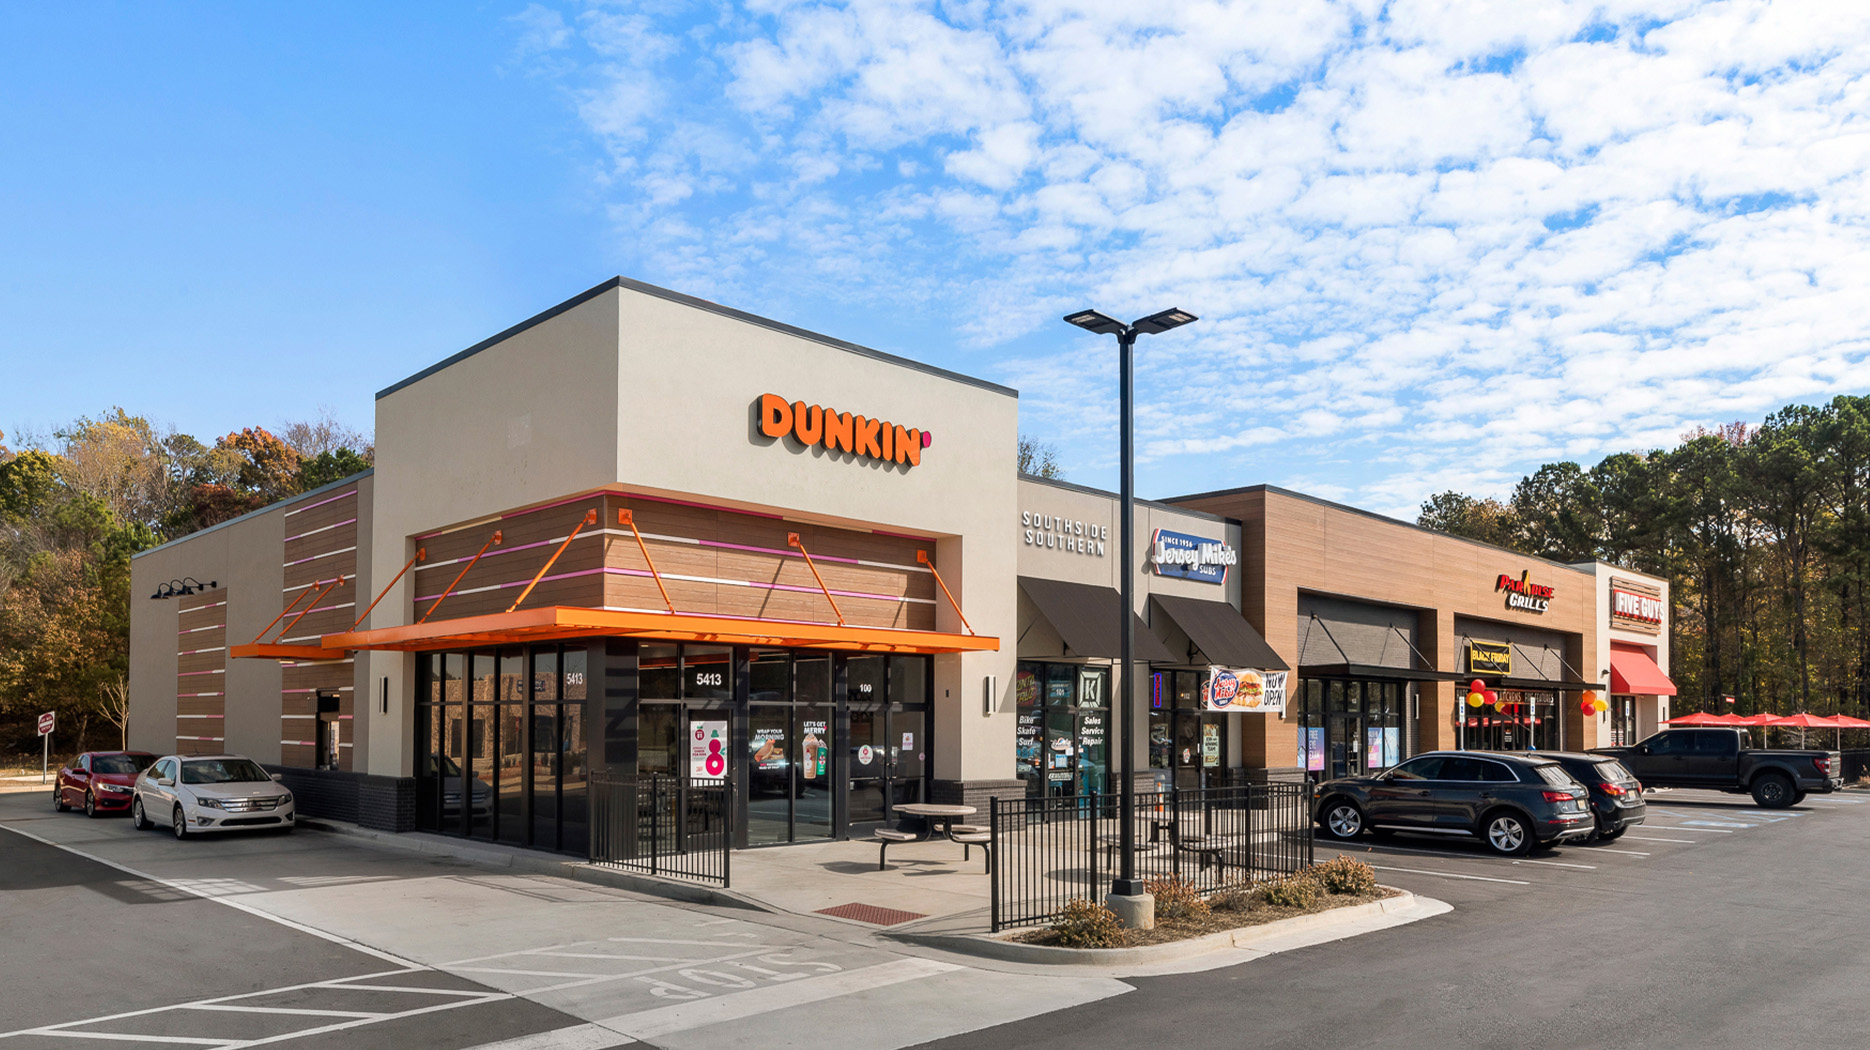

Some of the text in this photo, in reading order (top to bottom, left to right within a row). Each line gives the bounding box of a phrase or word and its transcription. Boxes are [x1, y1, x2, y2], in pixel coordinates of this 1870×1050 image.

[757, 393, 931, 466] DUNKIN'
[1022, 511, 1107, 540] SOUTHSIDE
[1025, 529, 1105, 556] SOUTHERN
[1161, 536, 1193, 548] SINCE 1956
[1154, 540, 1237, 571] Jersey Mike's
[1199, 565, 1217, 576] SUBS
[1508, 593, 1549, 612] GRILLS
[1615, 592, 1664, 620] FIVE GUYS
[1491, 652, 1510, 664] FRIDAY
[566, 672, 583, 685] 5413
[696, 673, 721, 686] 5413
[1265, 673, 1286, 689] NOW
[860, 684, 872, 693] 100
[1084, 679, 1097, 700] K
[1263, 689, 1283, 706] OPEN
[1018, 716, 1034, 724] Bike
[1084, 716, 1101, 725] Sales
[1017, 726, 1036, 735] Skate
[1081, 726, 1104, 735] Service
[1308, 729, 1319, 740] FREE
[1018, 737, 1034, 746] Surf
[1082, 737, 1103, 747] Repair
[633, 953, 843, 1000] STOP
